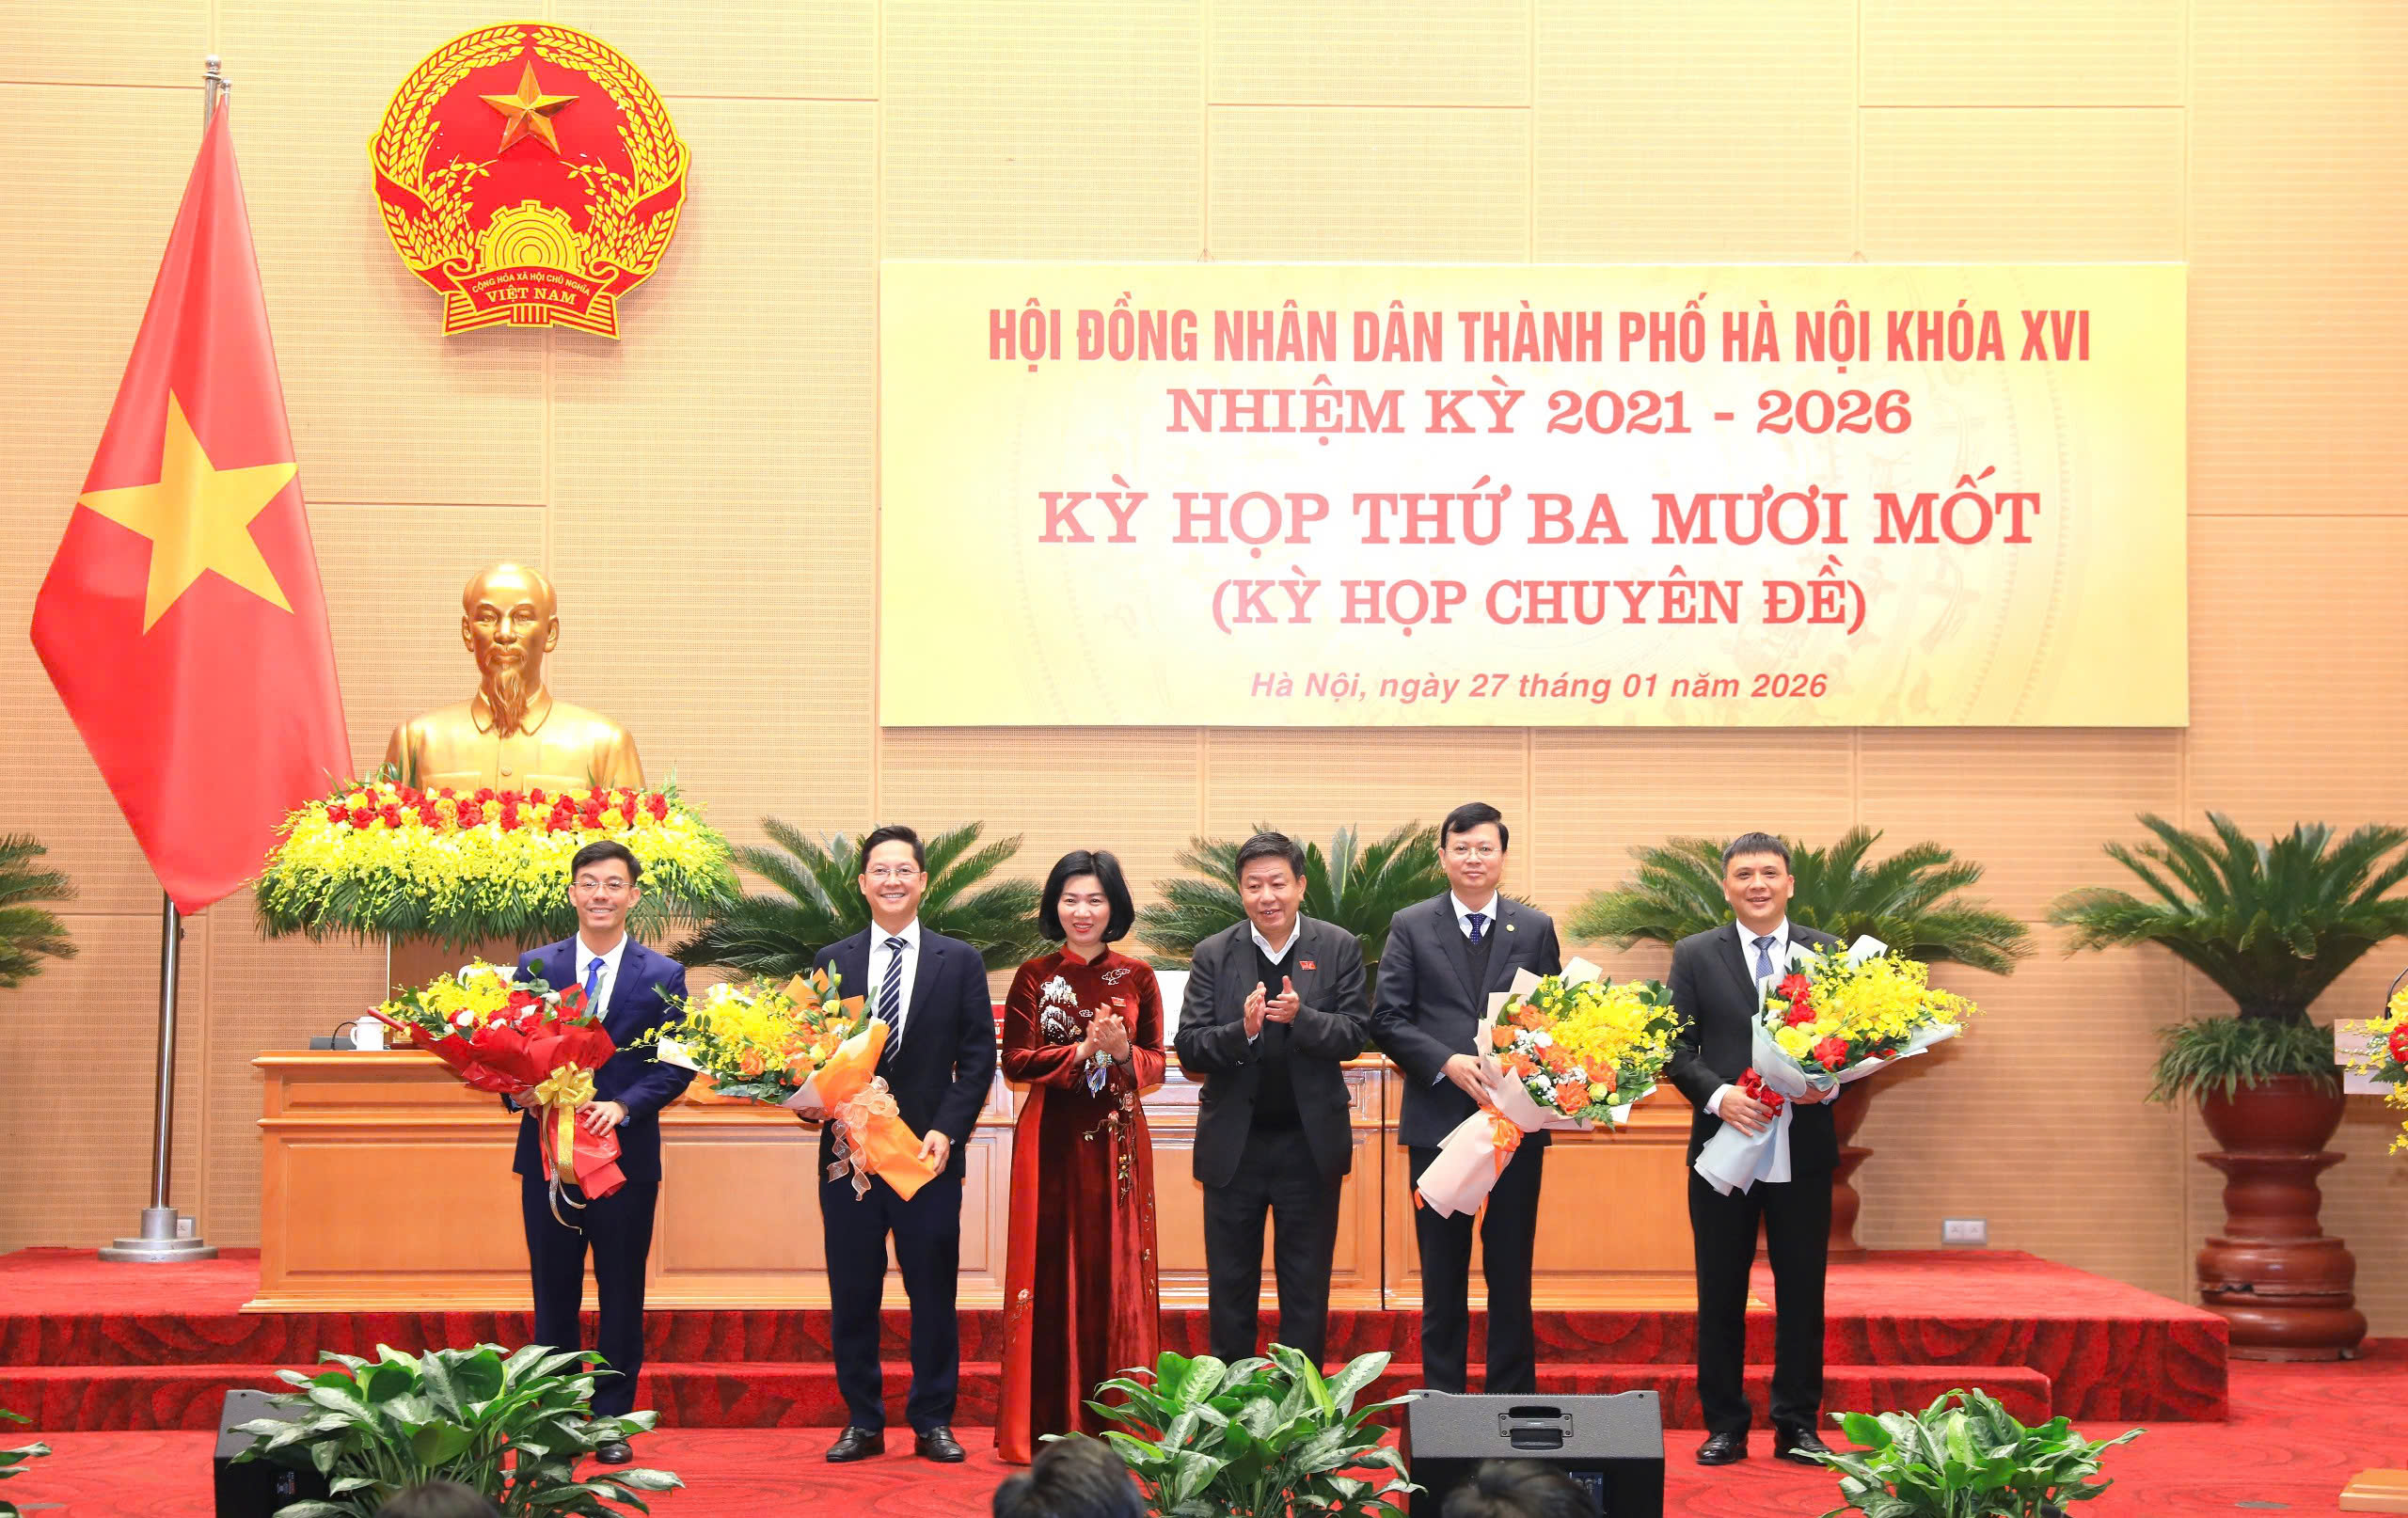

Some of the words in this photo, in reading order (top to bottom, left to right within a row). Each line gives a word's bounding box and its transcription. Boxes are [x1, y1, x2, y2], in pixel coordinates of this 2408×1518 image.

[472, 278, 496, 293] CỘNG
[516, 271, 529, 281] XÃ
[530, 272, 545, 283] HỘI
[546, 274, 564, 285] CHỦ
[564, 278, 591, 295] NGHĨA
[485, 284, 529, 302] VIỆT
[533, 287, 577, 305] NAM
[990, 297, 1060, 372] HỘI
[1077, 292, 1197, 362] ĐỒNG
[1215, 299, 1337, 362] NHÂN
[1354, 300, 1442, 362] DÂN
[1458, 299, 1602, 362] THÀNH
[1619, 292, 1707, 363] PHỐ
[1723, 300, 1780, 362] HÀ
[1796, 299, 1870, 374] NỘI
[1887, 298, 2005, 362] KHÓA
[2020, 309, 2090, 361] XVI
[1166, 373, 1405, 446] NHIỆM
[1425, 375, 1525, 434] KỲ
[1547, 389, 1692, 435] 2021
[1714, 412, 1735, 421] -
[1757, 389, 1912, 435] 2026
[1038, 474, 1148, 544] KỲ
[1173, 491, 1329, 559] HỌP
[1353, 474, 1512, 546] THỨ
[1527, 493, 1628, 545] BA
[1652, 483, 1848, 546] MƯƠI
[1873, 466, 2041, 546] MỐT
[1212, 565, 1321, 634] (KỲ
[1340, 578, 1466, 637] HỌP
[1485, 564, 1743, 625] CHUYÊN
[1762, 554, 1867, 635] ĐỀ)
[1251, 672, 1293, 697] Hà
[1305, 672, 1366, 703] Nội,
[1380, 672, 1460, 704] ngày
[1468, 672, 1510, 698] 27
[1519, 672, 1611, 704] tháng
[1623, 672, 1657, 698] 01
[1671, 672, 1740, 698] năm
[1750, 672, 1829, 698] 2026
